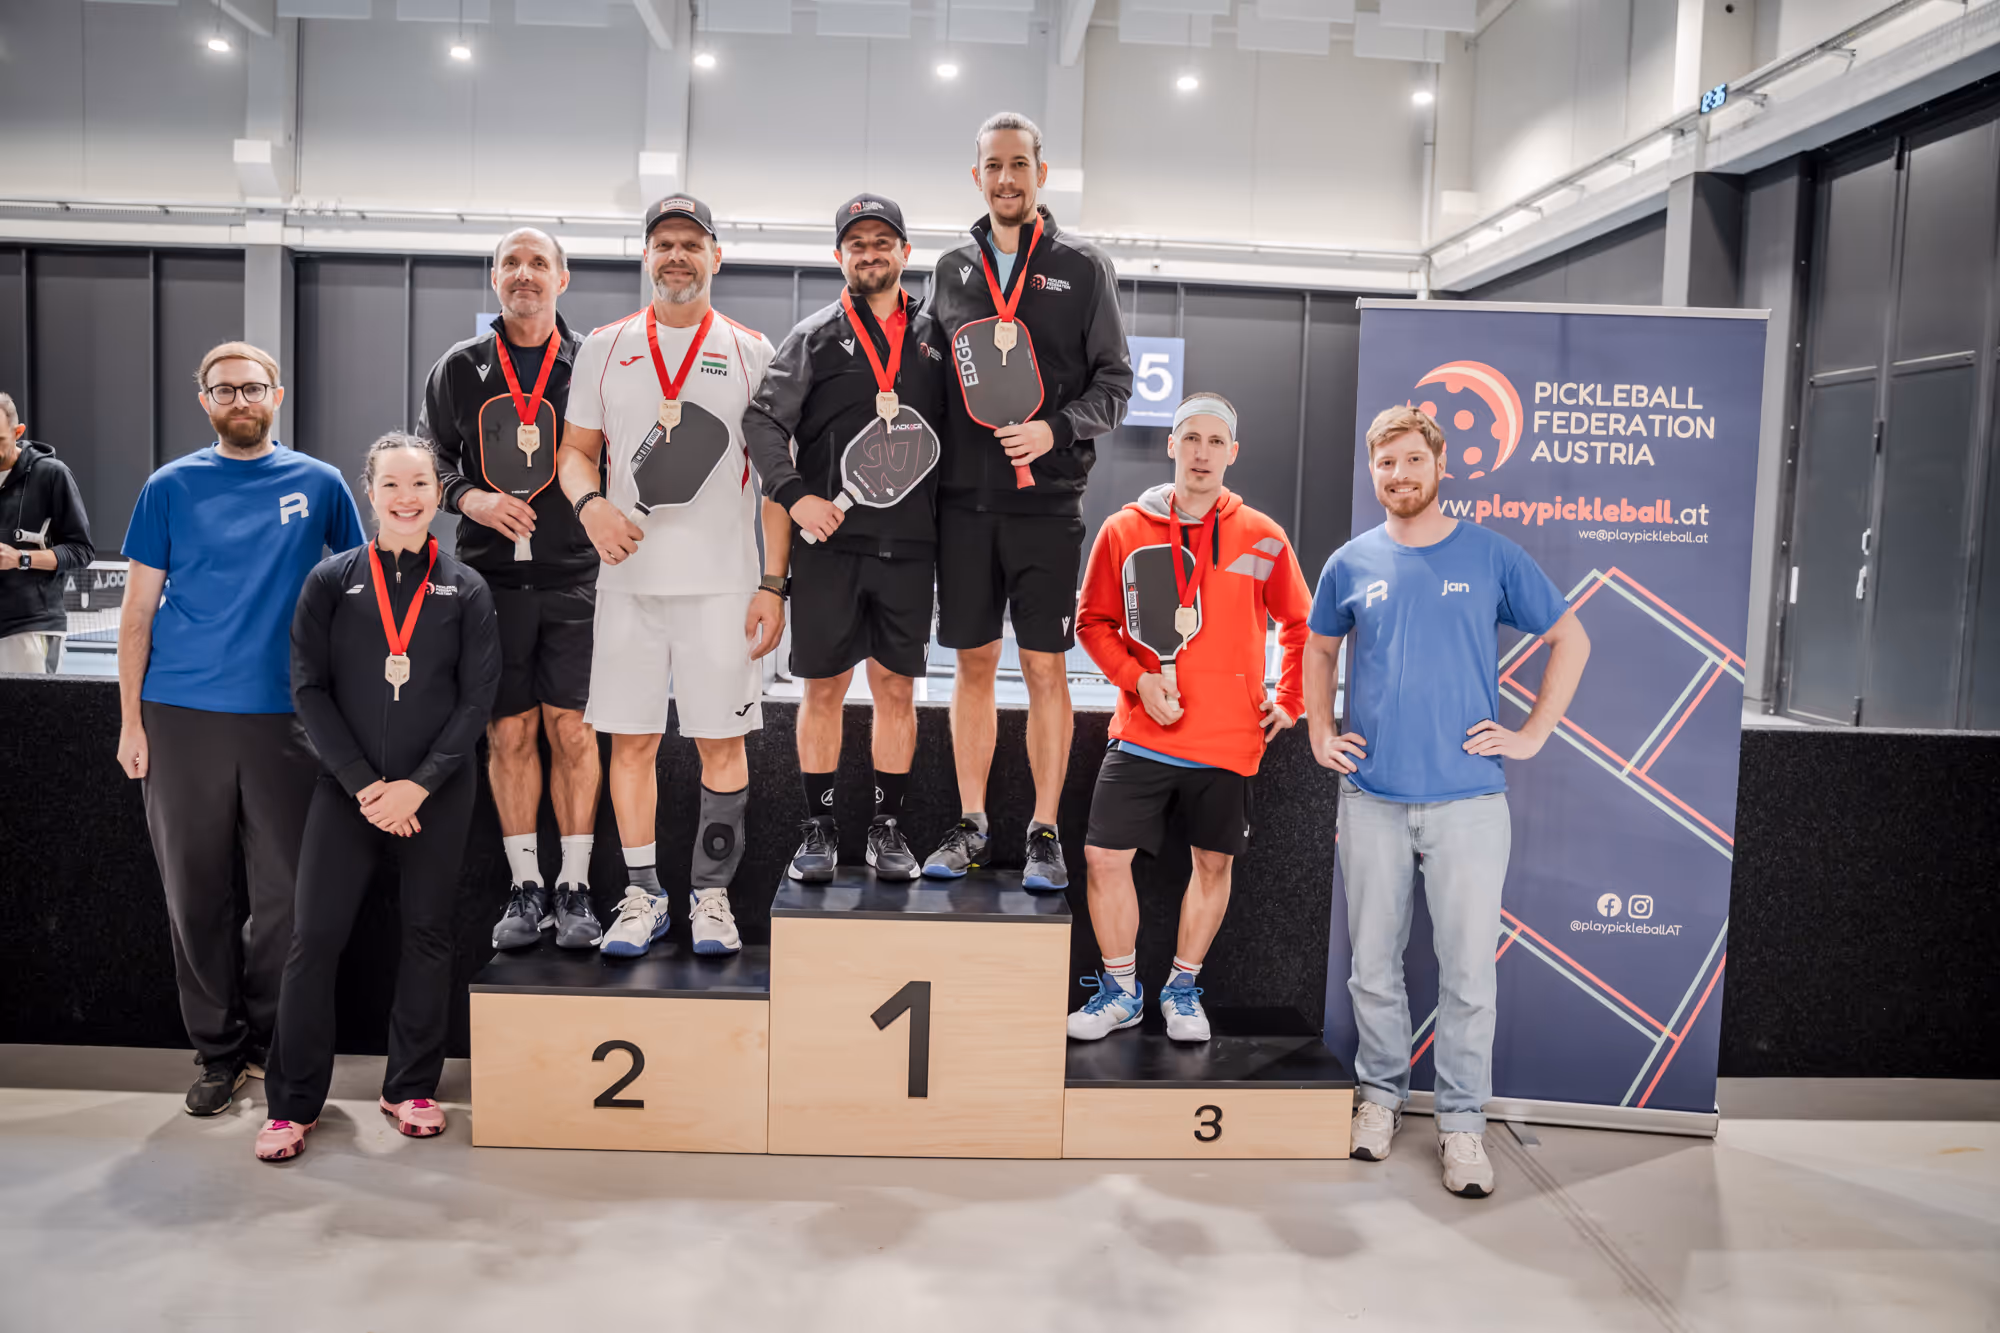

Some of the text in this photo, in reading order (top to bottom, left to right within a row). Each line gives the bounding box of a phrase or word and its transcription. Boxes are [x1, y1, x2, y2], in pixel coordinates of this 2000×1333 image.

[700, 367, 727, 377] HUN
[954, 334, 979, 388] EDGE
[1137, 353, 1173, 402] 5
[1534, 381, 1703, 410] PICKLEBALL
[1533, 411, 1715, 439] FEDERATION
[1530, 440, 1655, 466] AUSTRIA
[1578, 528, 1709, 544] we@playpickleball.at
[104, 571, 128, 588] JOO
[1441, 579, 1470, 596] jan
[1570, 920, 1682, 936] @playpickleballAT
[870, 981, 931, 1099] 1
[591, 1039, 645, 1109] 2
[1194, 1104, 1223, 1143] 3
